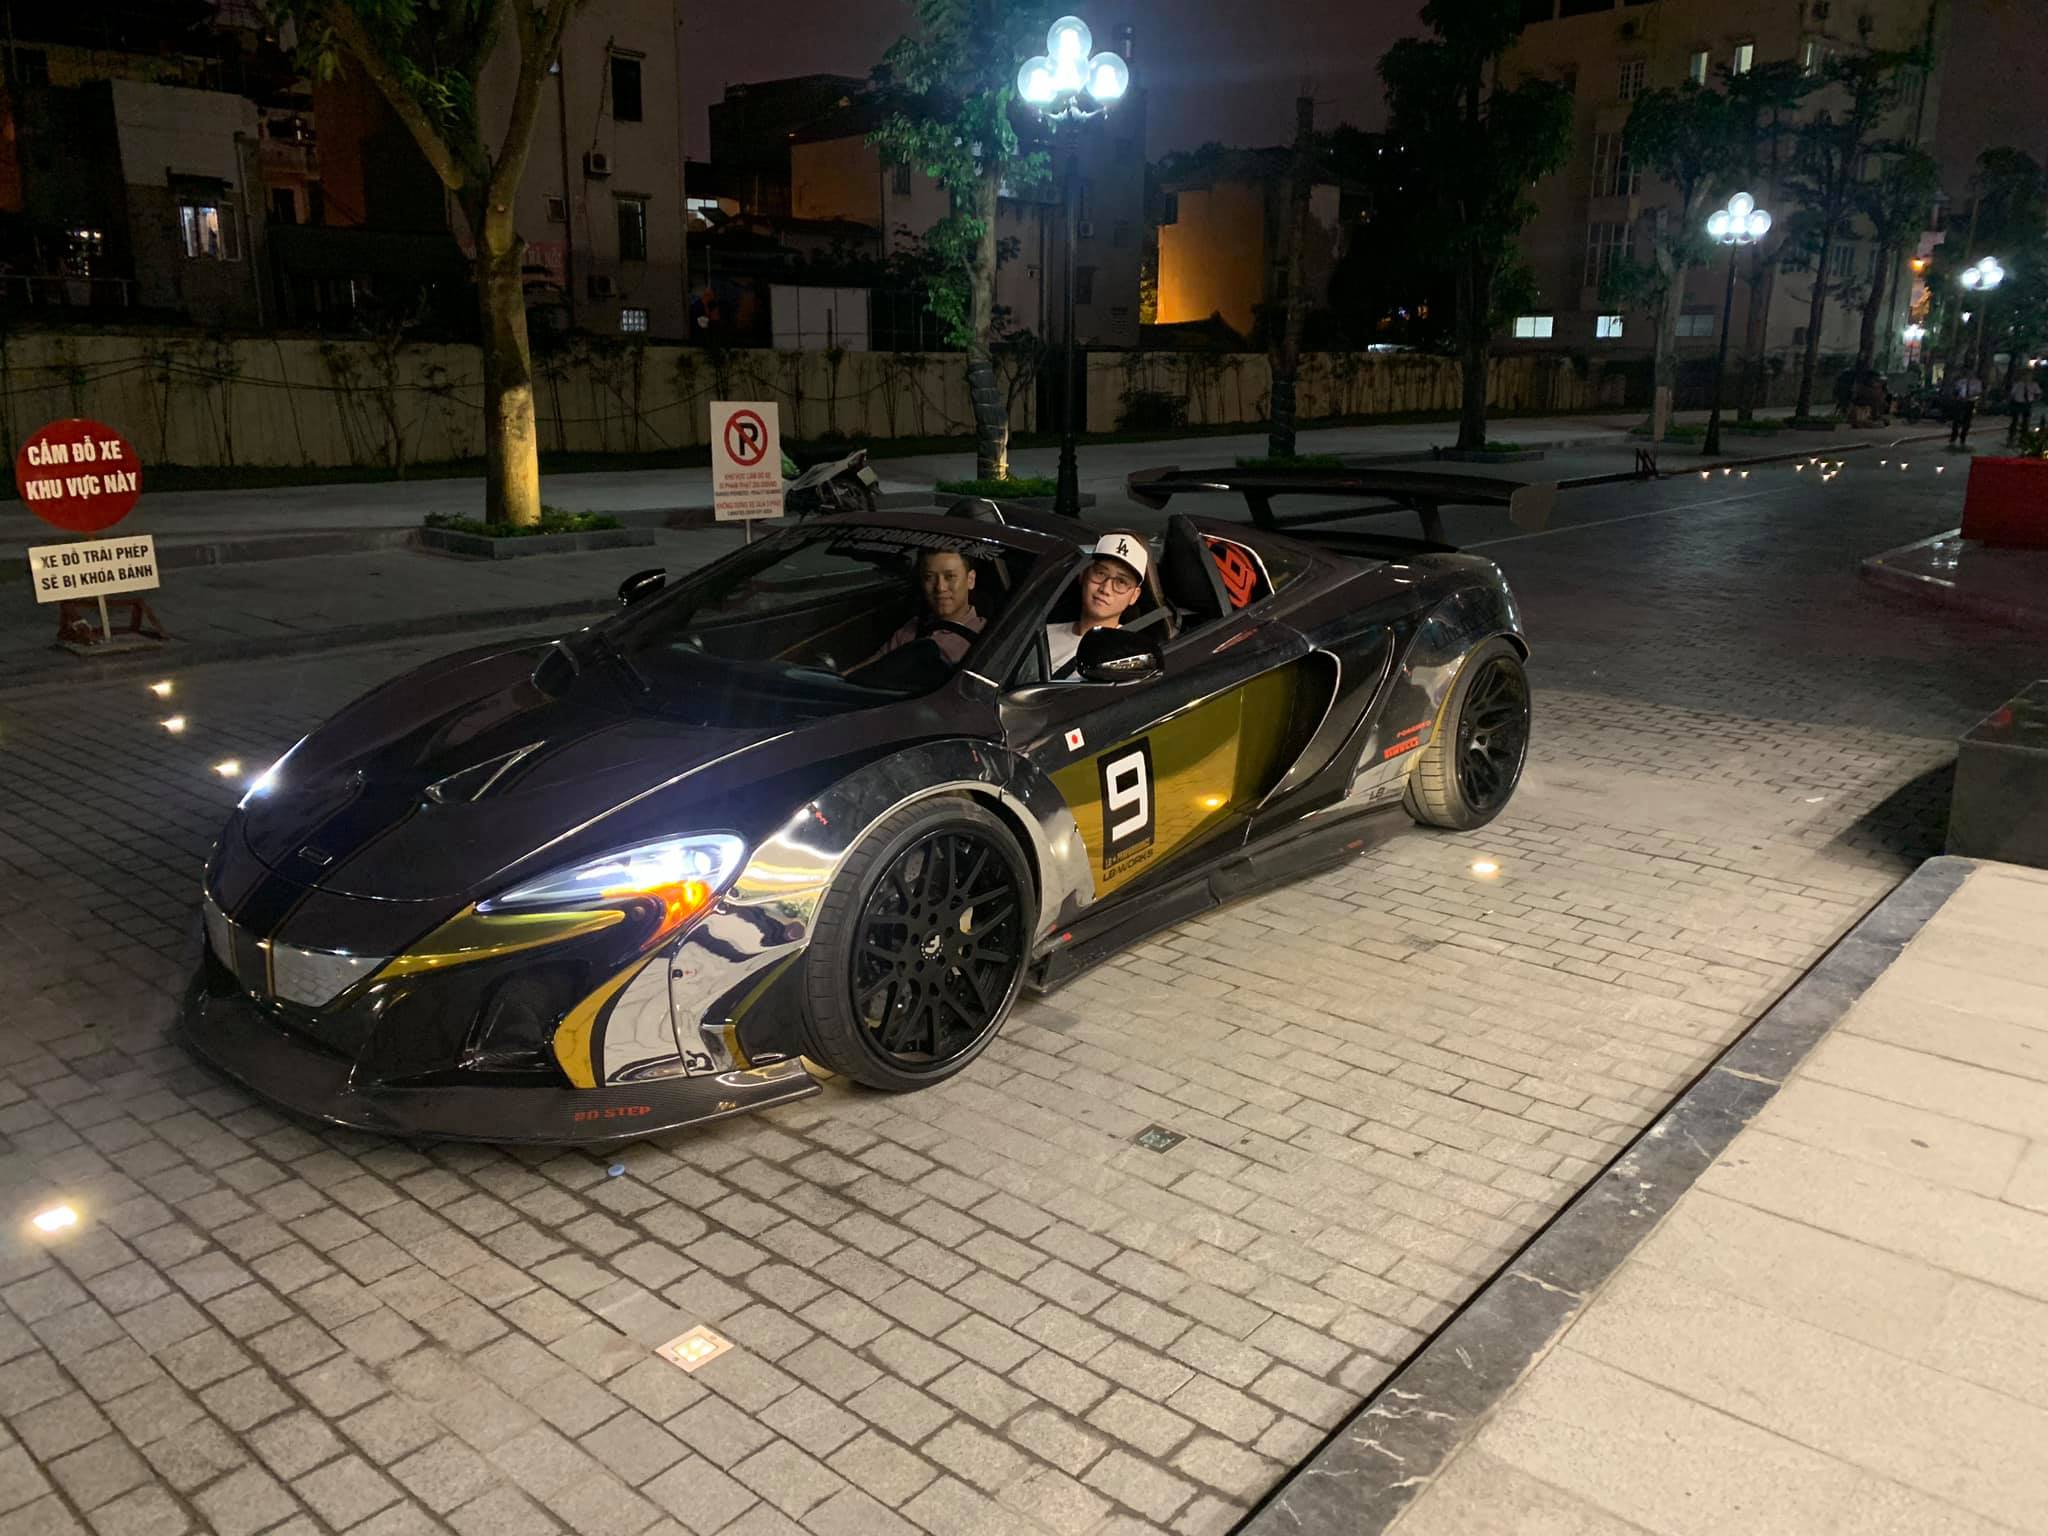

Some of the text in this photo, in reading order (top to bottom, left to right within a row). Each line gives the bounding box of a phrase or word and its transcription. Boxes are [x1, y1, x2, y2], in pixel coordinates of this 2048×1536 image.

[27, 435, 123, 466] CẤM ĐỖ XE
[26, 469, 137, 500] KHU VỰC NÀY
[1115, 538, 1129, 557] LA
[40, 555, 59, 569] XE
[63, 574, 77, 589] BỊ
[1106, 750, 1149, 843] 9
